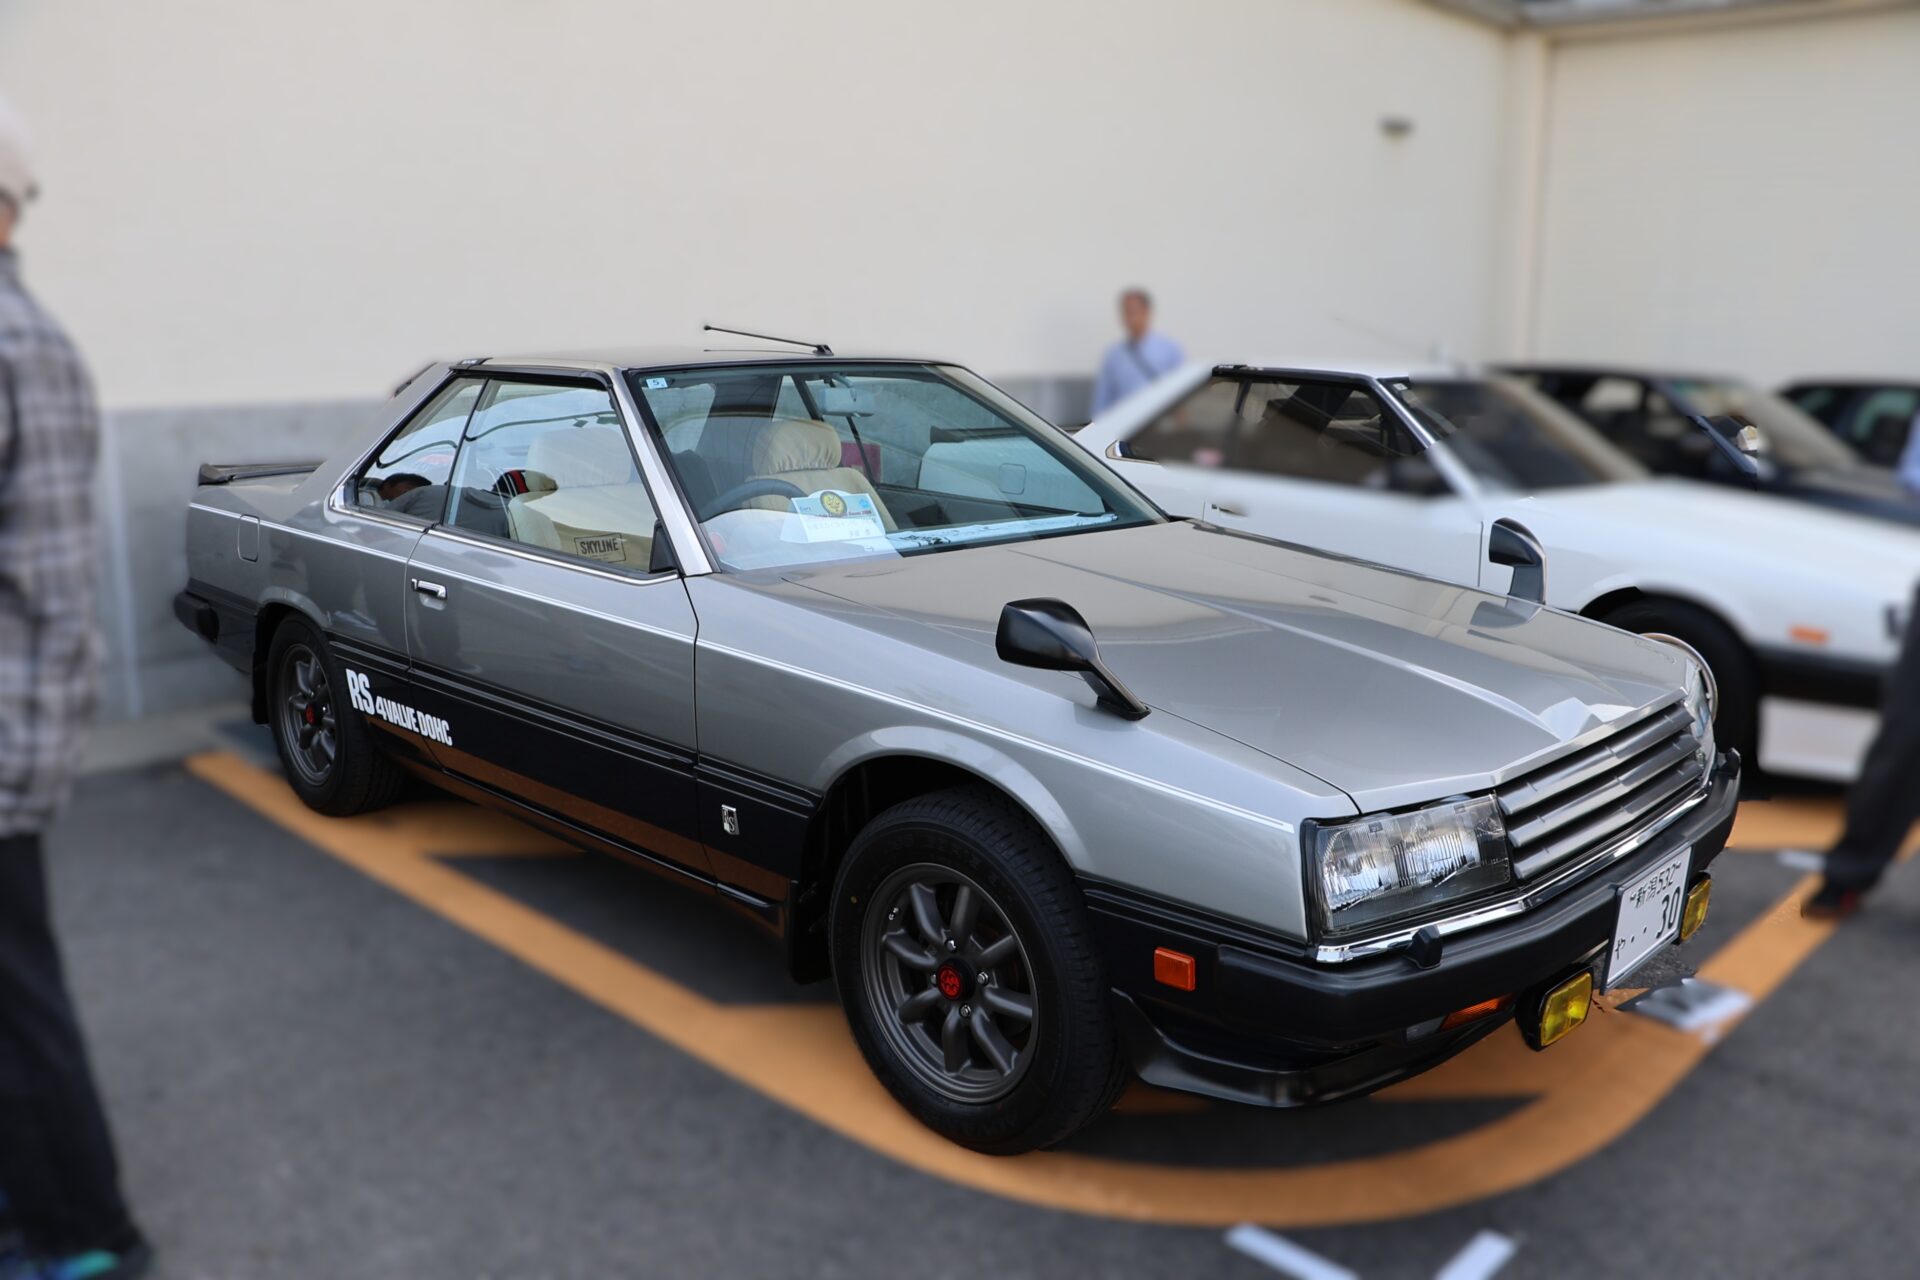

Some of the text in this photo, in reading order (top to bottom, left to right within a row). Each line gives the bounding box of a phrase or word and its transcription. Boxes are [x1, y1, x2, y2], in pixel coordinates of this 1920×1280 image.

[579, 537, 619, 555] SKYLINE
[345, 668, 375, 715] RS
[416, 710, 453, 746] DOHC
